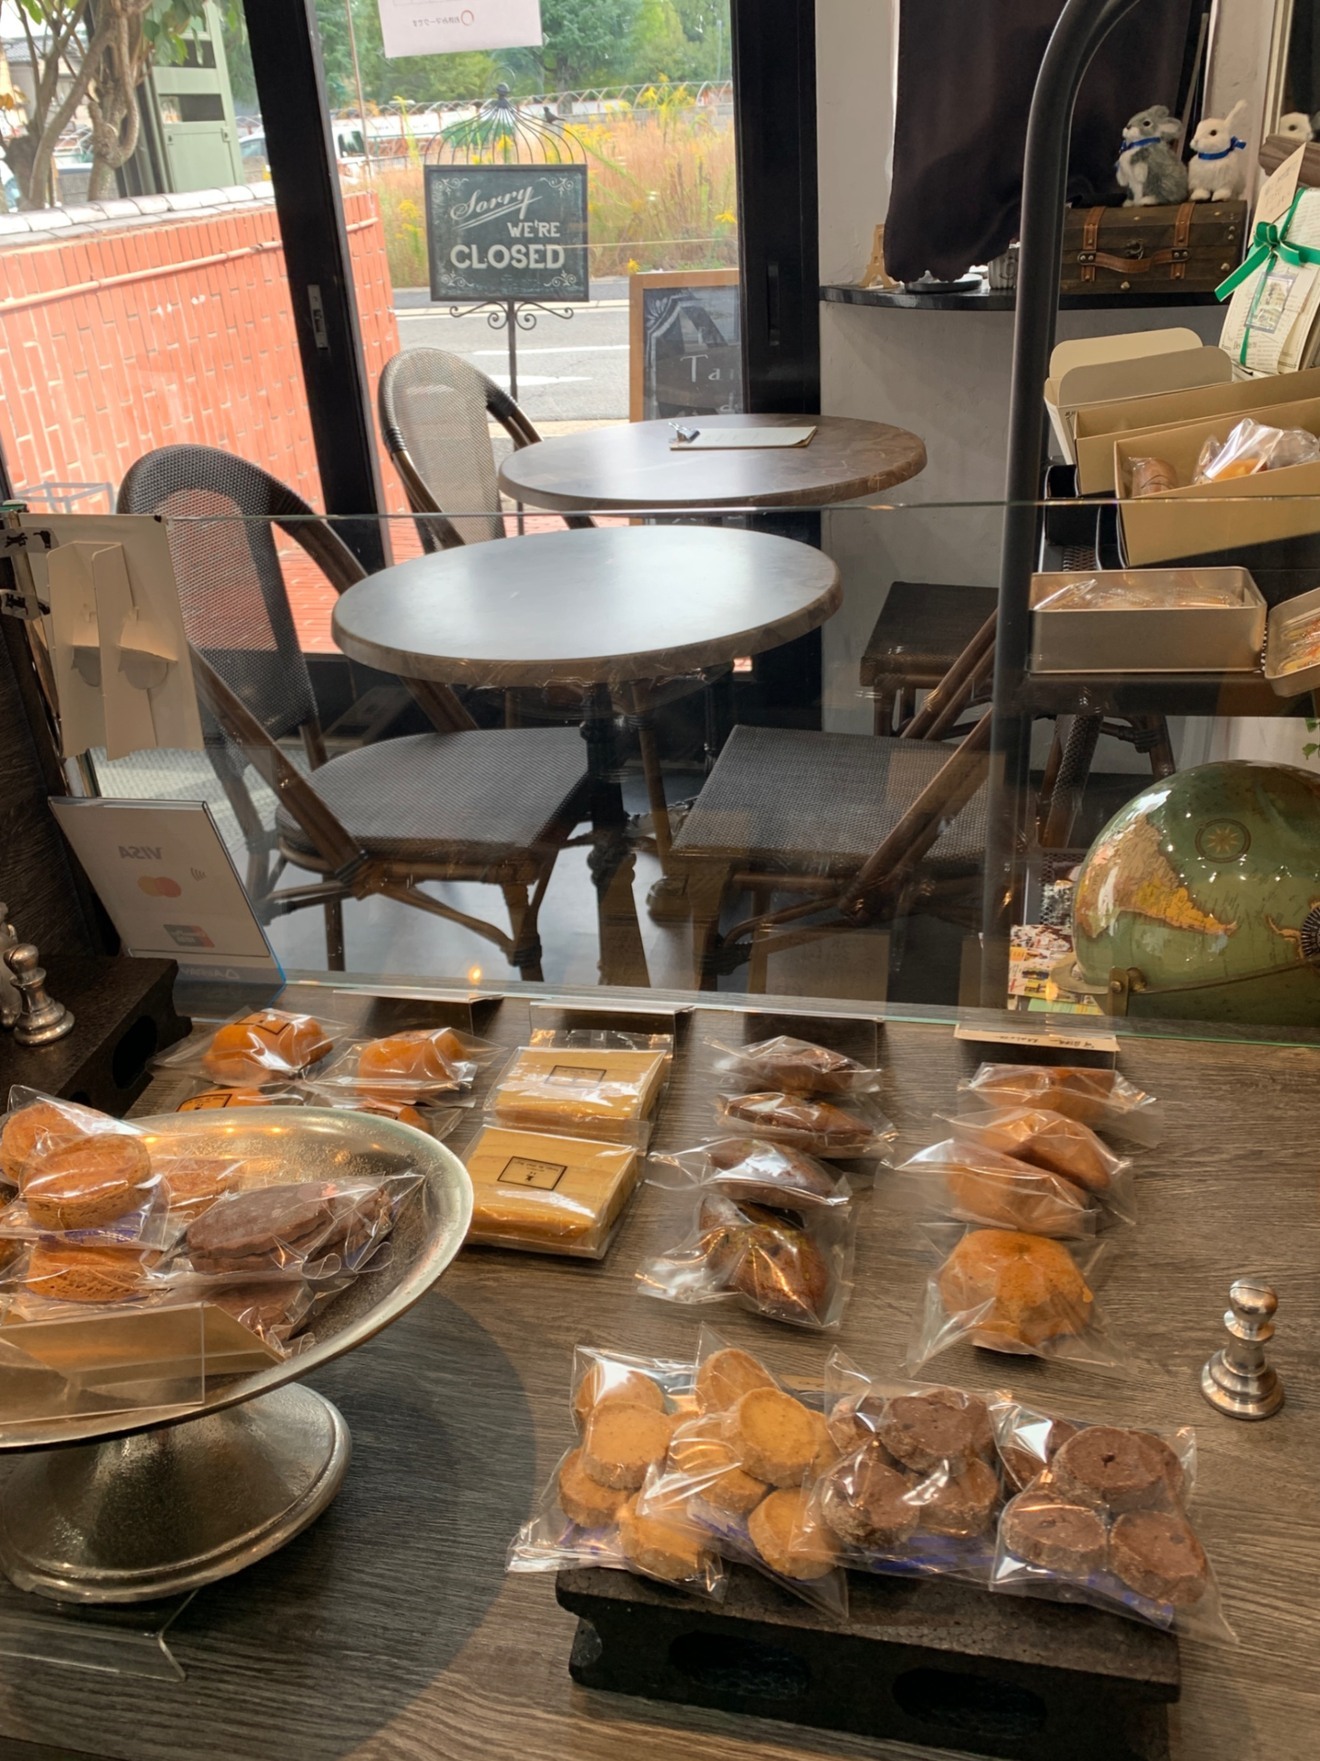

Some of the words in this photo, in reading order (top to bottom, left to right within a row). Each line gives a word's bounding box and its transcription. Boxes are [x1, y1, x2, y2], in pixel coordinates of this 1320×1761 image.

[450, 186, 535, 220] Sorry
[507, 219, 561, 238] WE'RE
[450, 243, 566, 269] CLOSED
